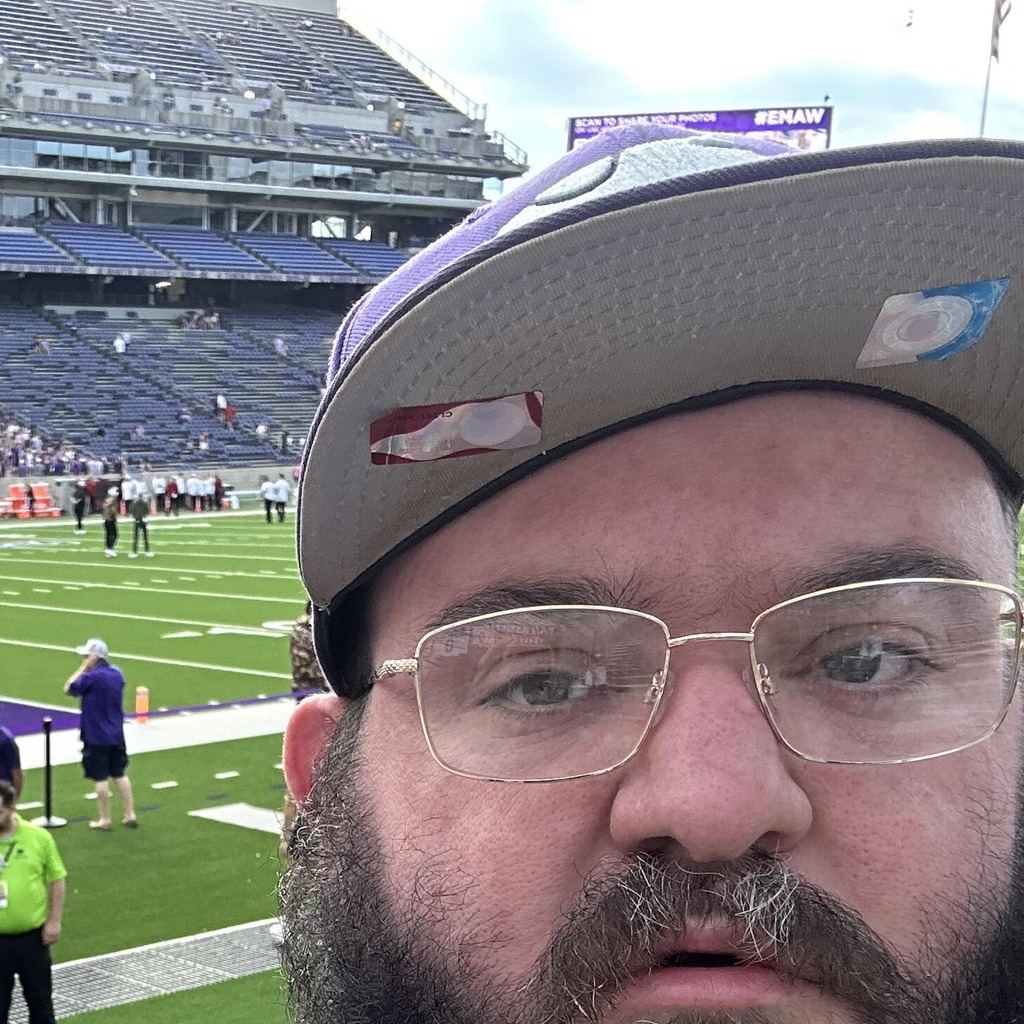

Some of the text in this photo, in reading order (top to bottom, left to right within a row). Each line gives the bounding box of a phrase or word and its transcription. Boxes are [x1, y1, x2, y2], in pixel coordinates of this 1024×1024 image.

[575, 118, 602, 127] SCAN
[603, 117, 616, 126] TO
[678, 112, 717, 123] PHOTOS
[754, 108, 826, 126] #ENAW
